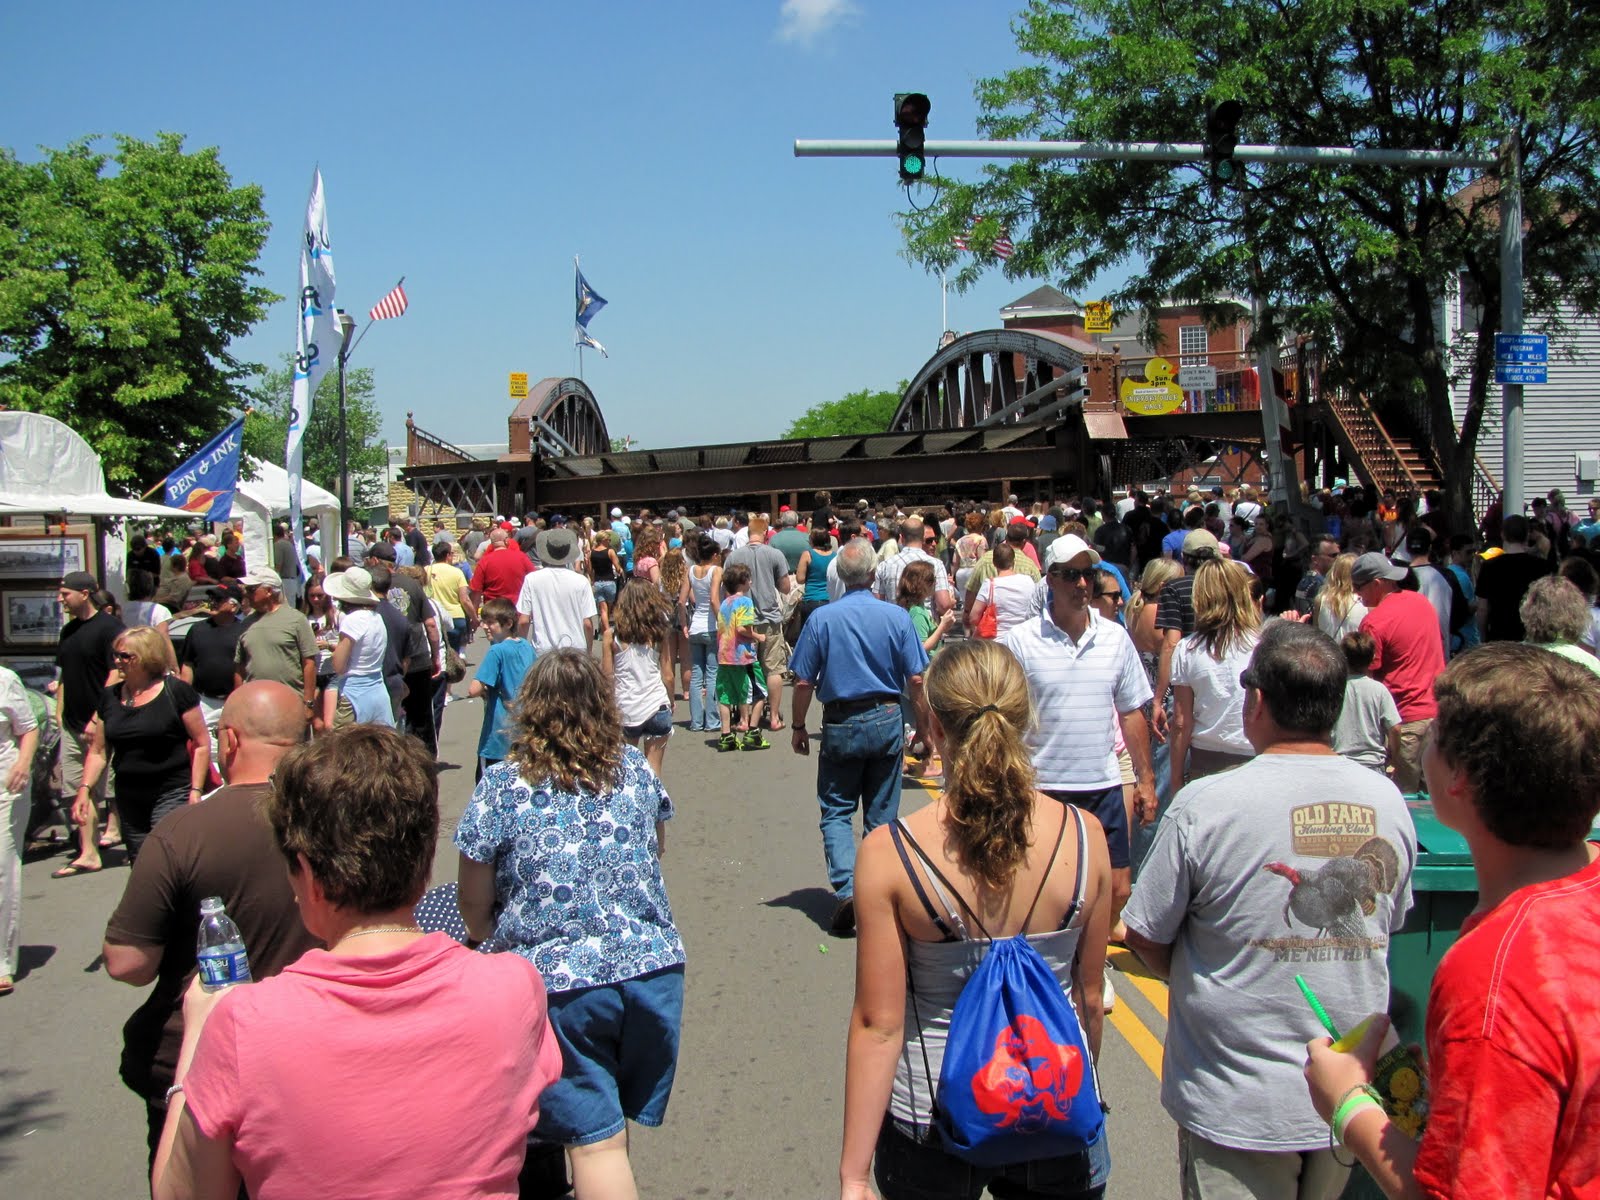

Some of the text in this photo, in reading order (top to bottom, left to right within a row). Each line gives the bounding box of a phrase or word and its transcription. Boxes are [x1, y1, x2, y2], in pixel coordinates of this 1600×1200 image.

[168, 434, 239, 500] PEN & INK
[1293, 803, 1374, 825] OLD FART
[1299, 823, 1370, 836] Hunting Club
[1274, 944, 1371, 962] ME NEITHER
